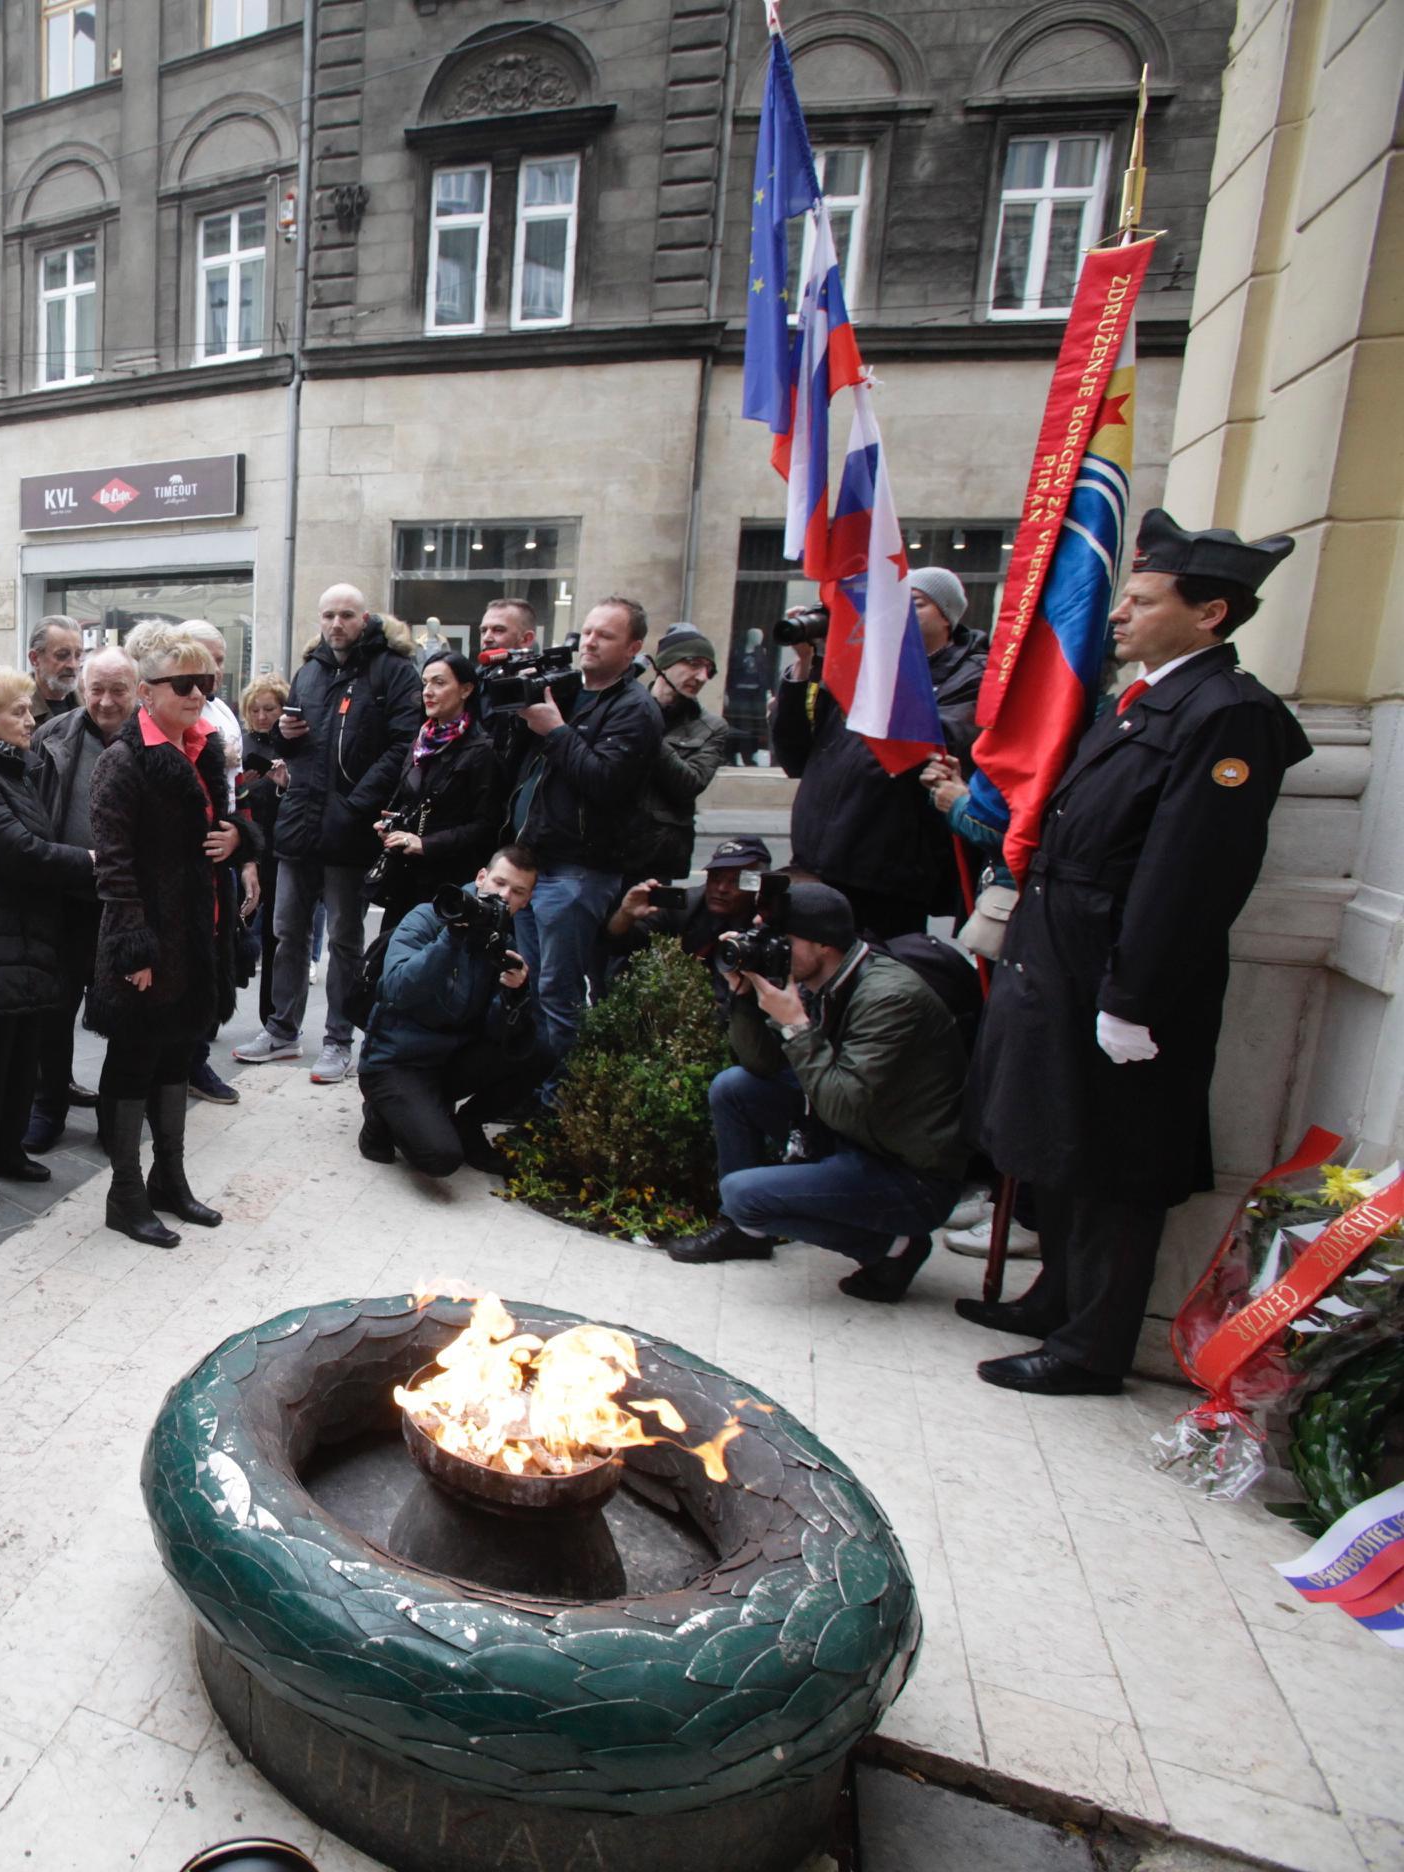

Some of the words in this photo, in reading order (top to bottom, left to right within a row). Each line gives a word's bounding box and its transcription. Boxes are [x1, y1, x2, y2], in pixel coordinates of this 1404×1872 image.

[1078, 273, 1131, 399] ZDRUŽENJE
[1054, 404, 1088, 489] BORCEV
[45, 487, 78, 510] KVL
[154, 483, 198, 498] TIMEOUT
[1027, 453, 1057, 523] PIRAN
[1043, 495, 1061, 523] ZA
[1010, 528, 1049, 636] VREDNOTE
[1229, 1284, 1299, 1342] CENTAR
